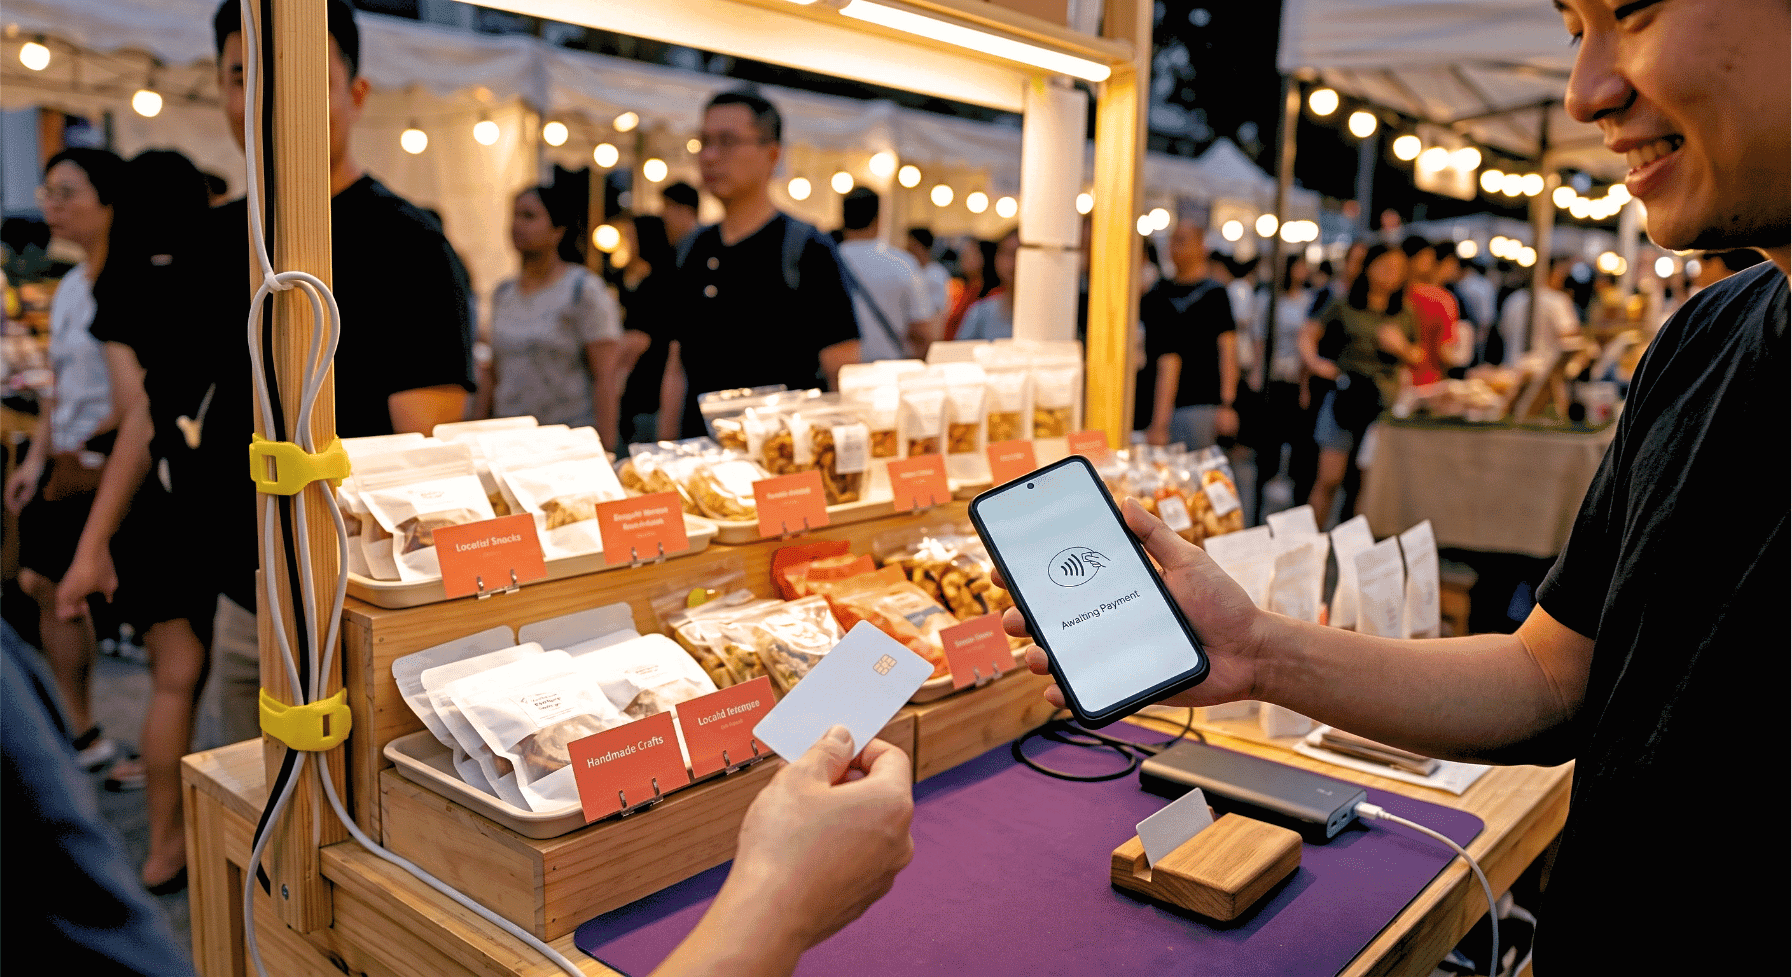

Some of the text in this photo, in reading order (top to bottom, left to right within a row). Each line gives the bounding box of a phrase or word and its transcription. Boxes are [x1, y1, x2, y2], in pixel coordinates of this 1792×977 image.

[491, 534, 522, 546] Snacks
[1061, 590, 1140, 631] Awaiting Payment
[586, 736, 664, 769] Handmade Crafts
